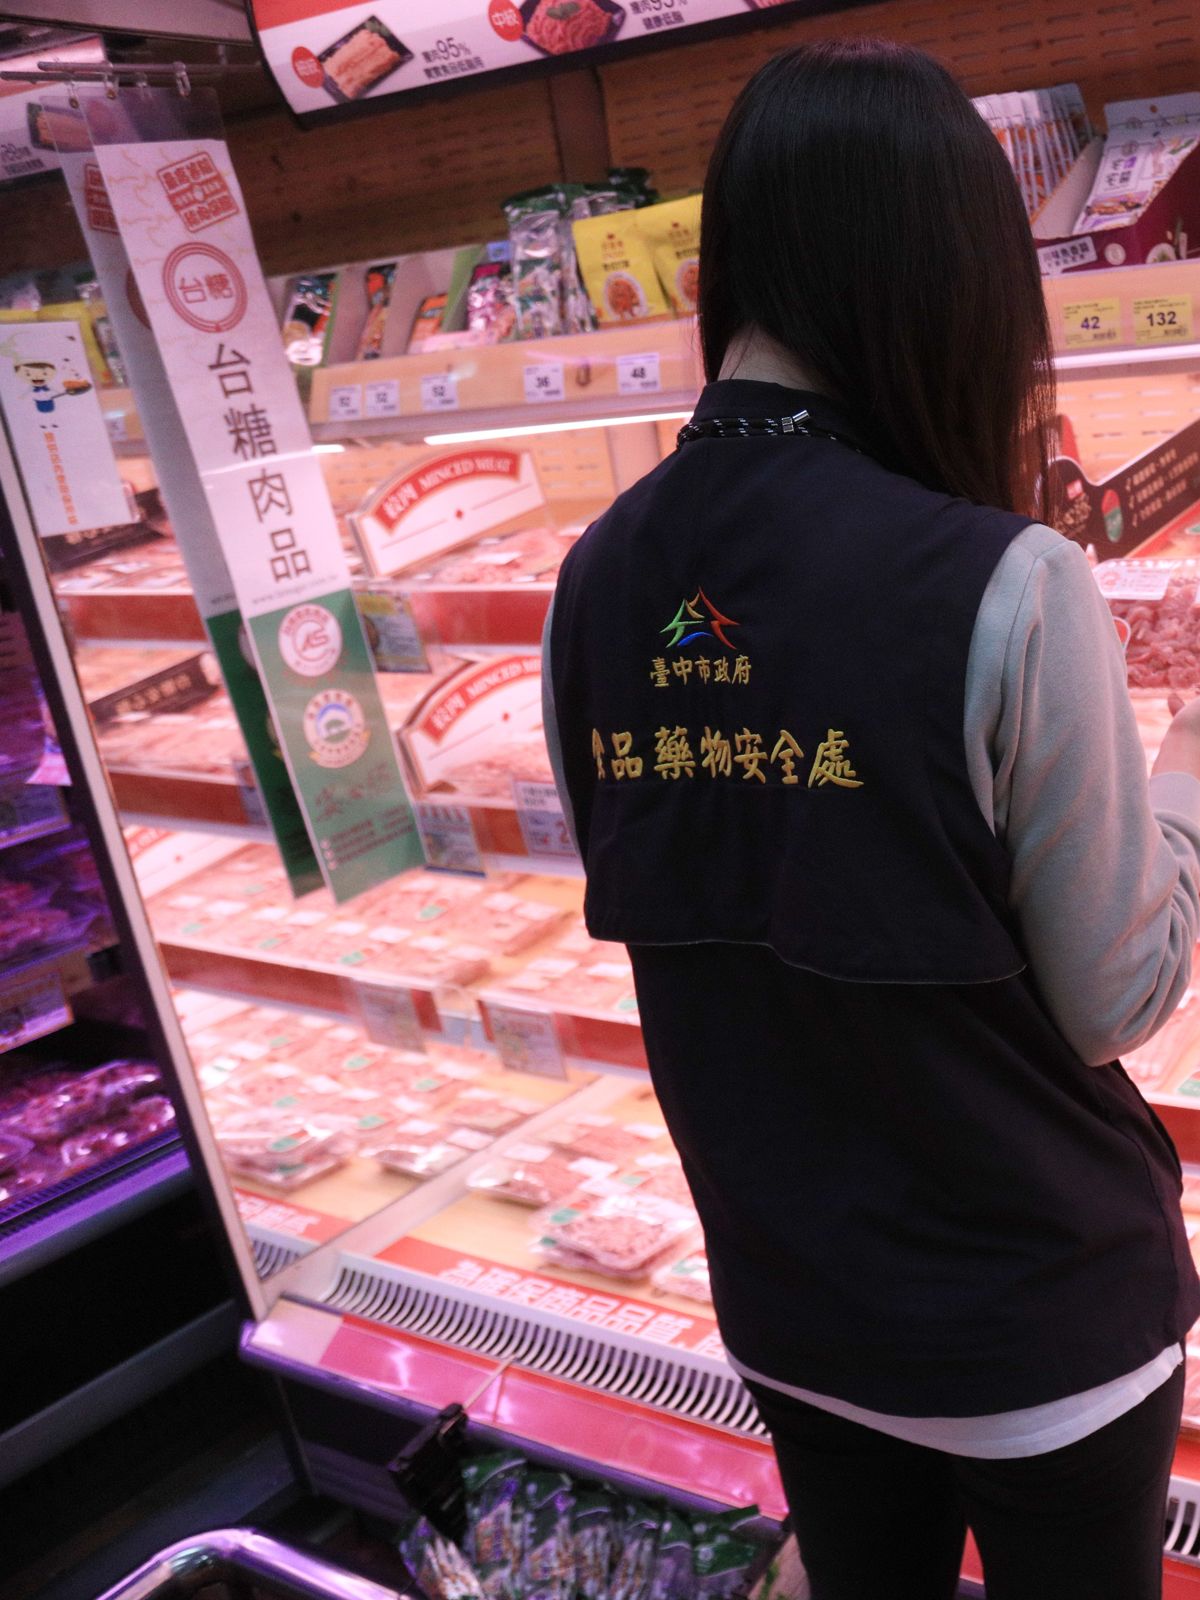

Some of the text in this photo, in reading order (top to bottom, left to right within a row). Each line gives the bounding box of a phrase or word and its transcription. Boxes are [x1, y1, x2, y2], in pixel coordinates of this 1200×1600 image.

[1081, 316, 1100, 330] 42
[1146, 311, 1177, 327] 132
[207, 342, 313, 584] 台糖肉品
[650, 654, 752, 688] 臺中市政府
